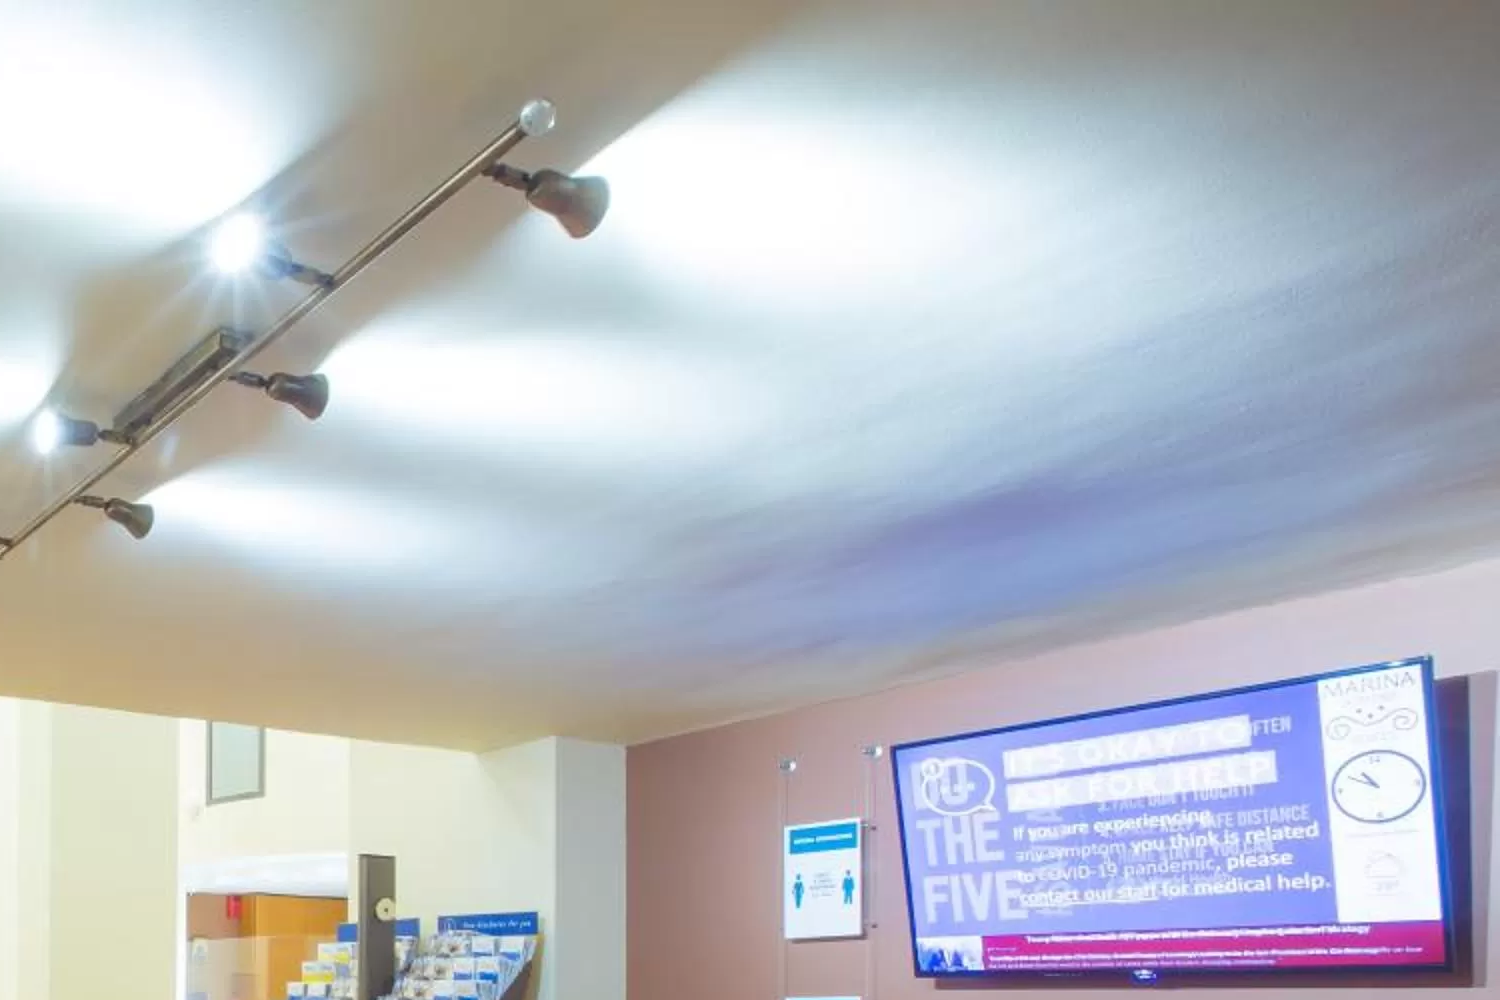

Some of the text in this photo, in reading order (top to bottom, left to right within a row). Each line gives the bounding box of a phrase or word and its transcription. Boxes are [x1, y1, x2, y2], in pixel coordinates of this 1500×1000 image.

[1078, 731, 1176, 765] OKAY
[1192, 721, 1247, 747] TO
[1250, 716, 1293, 738] FTEN
[1089, 769, 1160, 799] FOR
[1174, 756, 1271, 791] HELP
[1012, 825, 1025, 842] If
[1093, 809, 1212, 838] experiencing
[1237, 804, 1311, 828] DISTANCE
[916, 810, 1005, 866] THE
[1131, 838, 1164, 858] you
[1169, 831, 1220, 851] think
[1223, 829, 1240, 846] is
[1244, 820, 1320, 844] related
[1123, 855, 1222, 880] pandemic,
[1226, 851, 1294, 872] please
[923, 869, 1029, 924] FIVE
[1019, 888, 1078, 905] contact
[1116, 882, 1156, 900] staff
[1163, 881, 1190, 897] for
[1193, 874, 1273, 895] medical
[1277, 871, 1332, 893] help.
